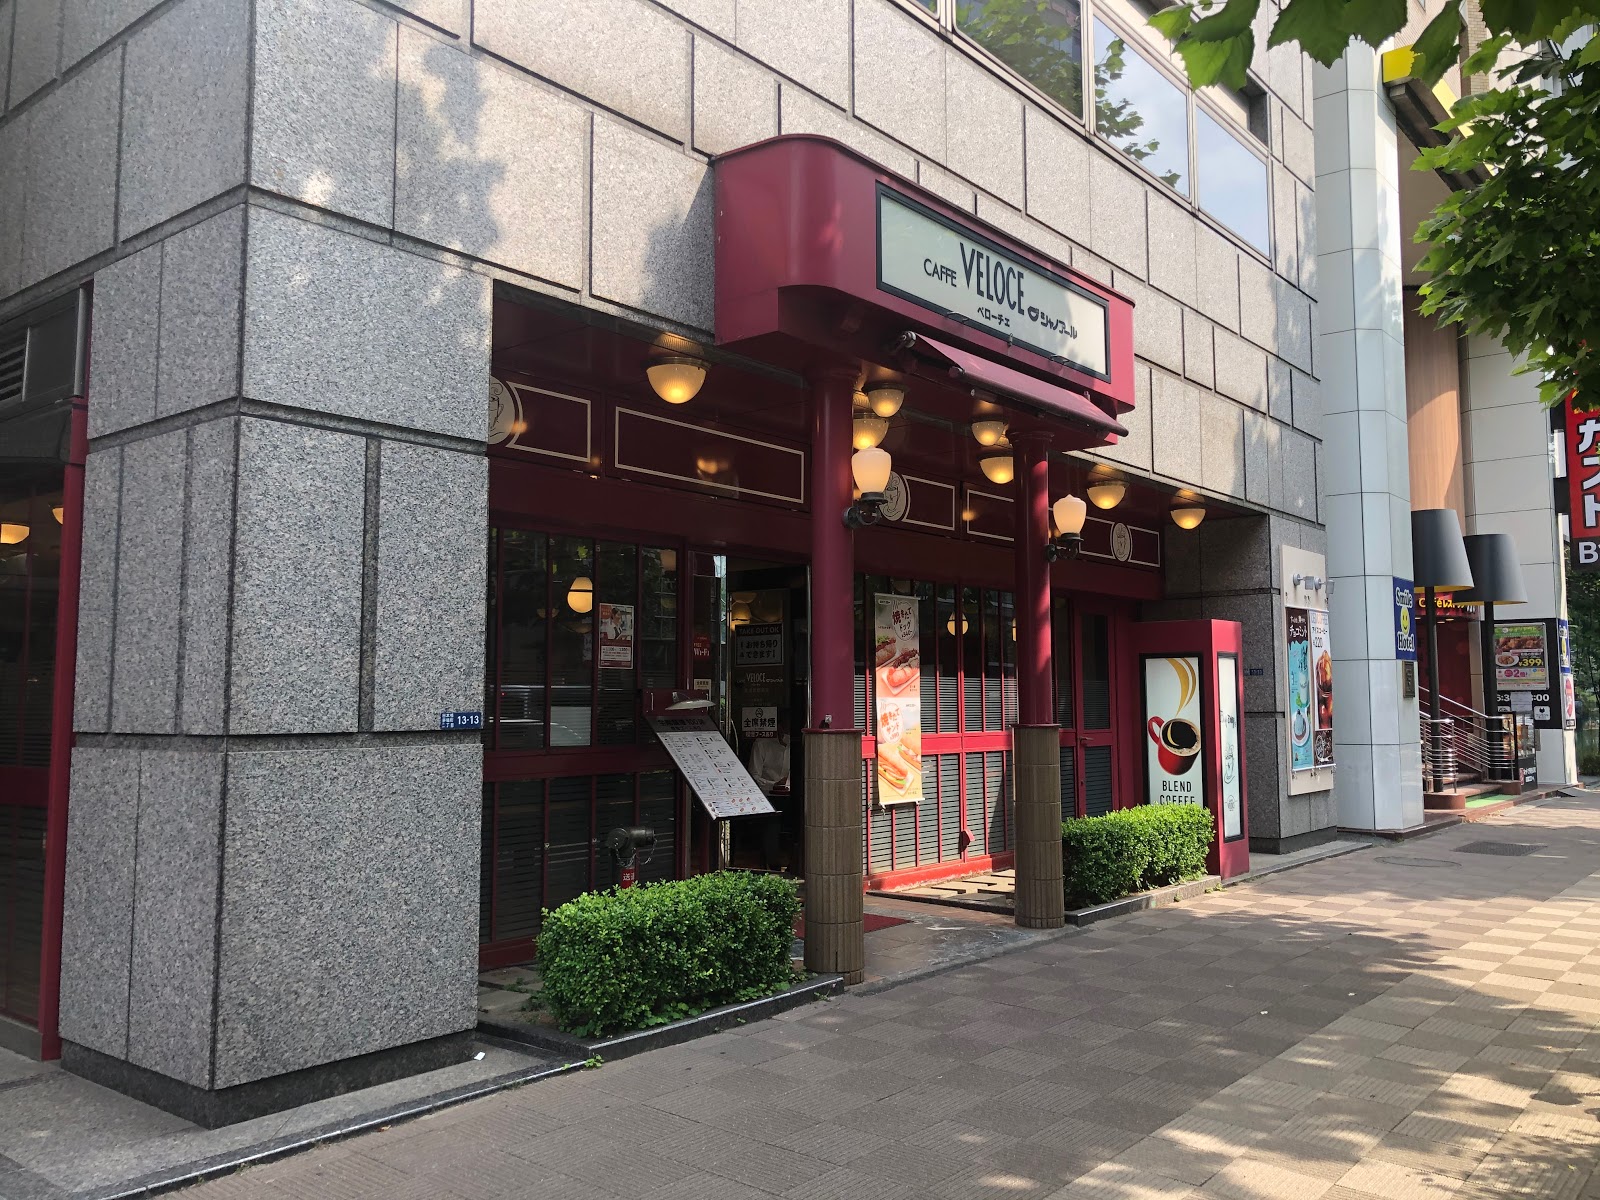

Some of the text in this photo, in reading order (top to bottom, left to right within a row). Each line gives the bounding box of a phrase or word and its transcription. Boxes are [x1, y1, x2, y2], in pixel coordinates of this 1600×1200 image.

[960, 242, 1025, 315] VELOCE
[977, 307, 1011, 328] ベローチェ
[1041, 311, 1078, 339] シャノアール
[1396, 587, 1413, 608] Smile
[693, 648, 710, 656] Wi-Fi
[1398, 632, 1415, 653] Hotel
[458, 715, 480, 725] 13-13
[744, 717, 776, 728] 全席禁煙
[1162, 780, 1192, 792] BLEND
